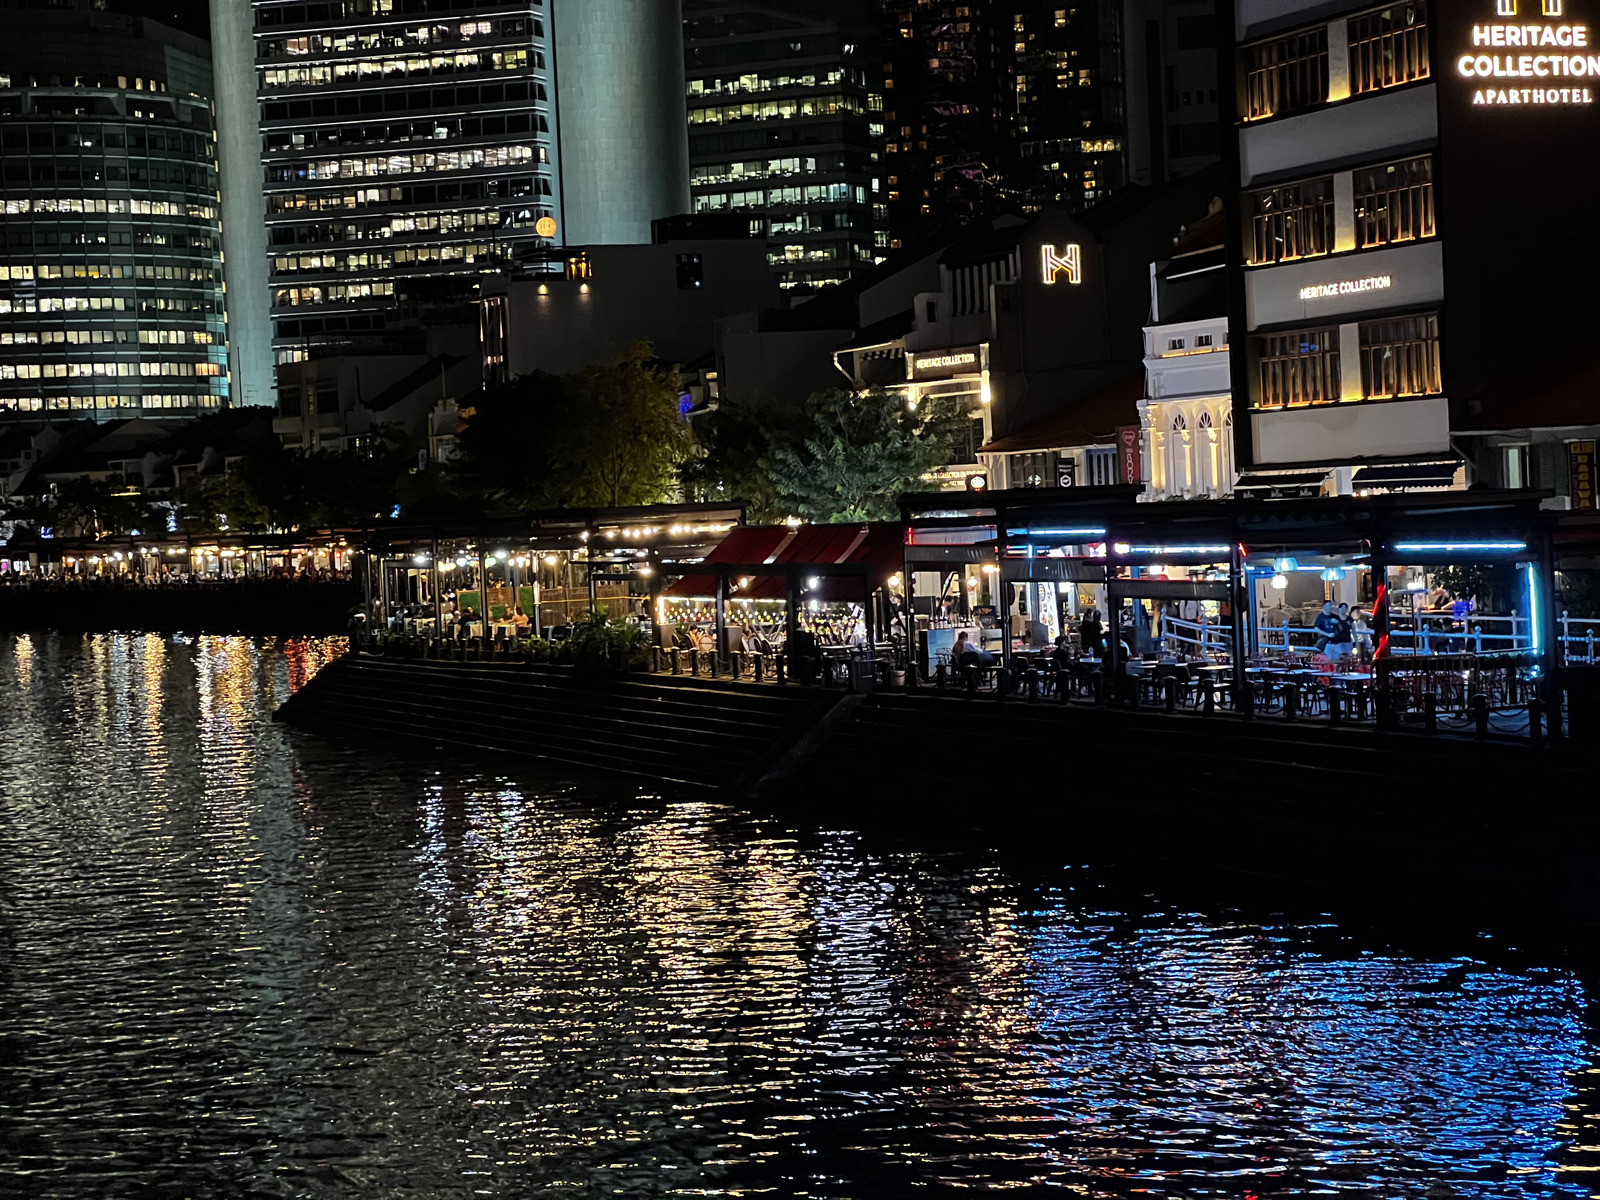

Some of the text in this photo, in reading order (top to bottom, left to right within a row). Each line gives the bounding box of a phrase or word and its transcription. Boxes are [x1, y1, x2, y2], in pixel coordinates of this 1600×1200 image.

[1472, 25, 1588, 47] HERITAGE
[1458, 55, 1600, 77] COLLECTION
[1473, 88, 1593, 105] APARTHOTEL
[1300, 275, 1391, 300] HERITAGE COLLECTION
[916, 353, 975, 369] HERITAGE COLLECTION
